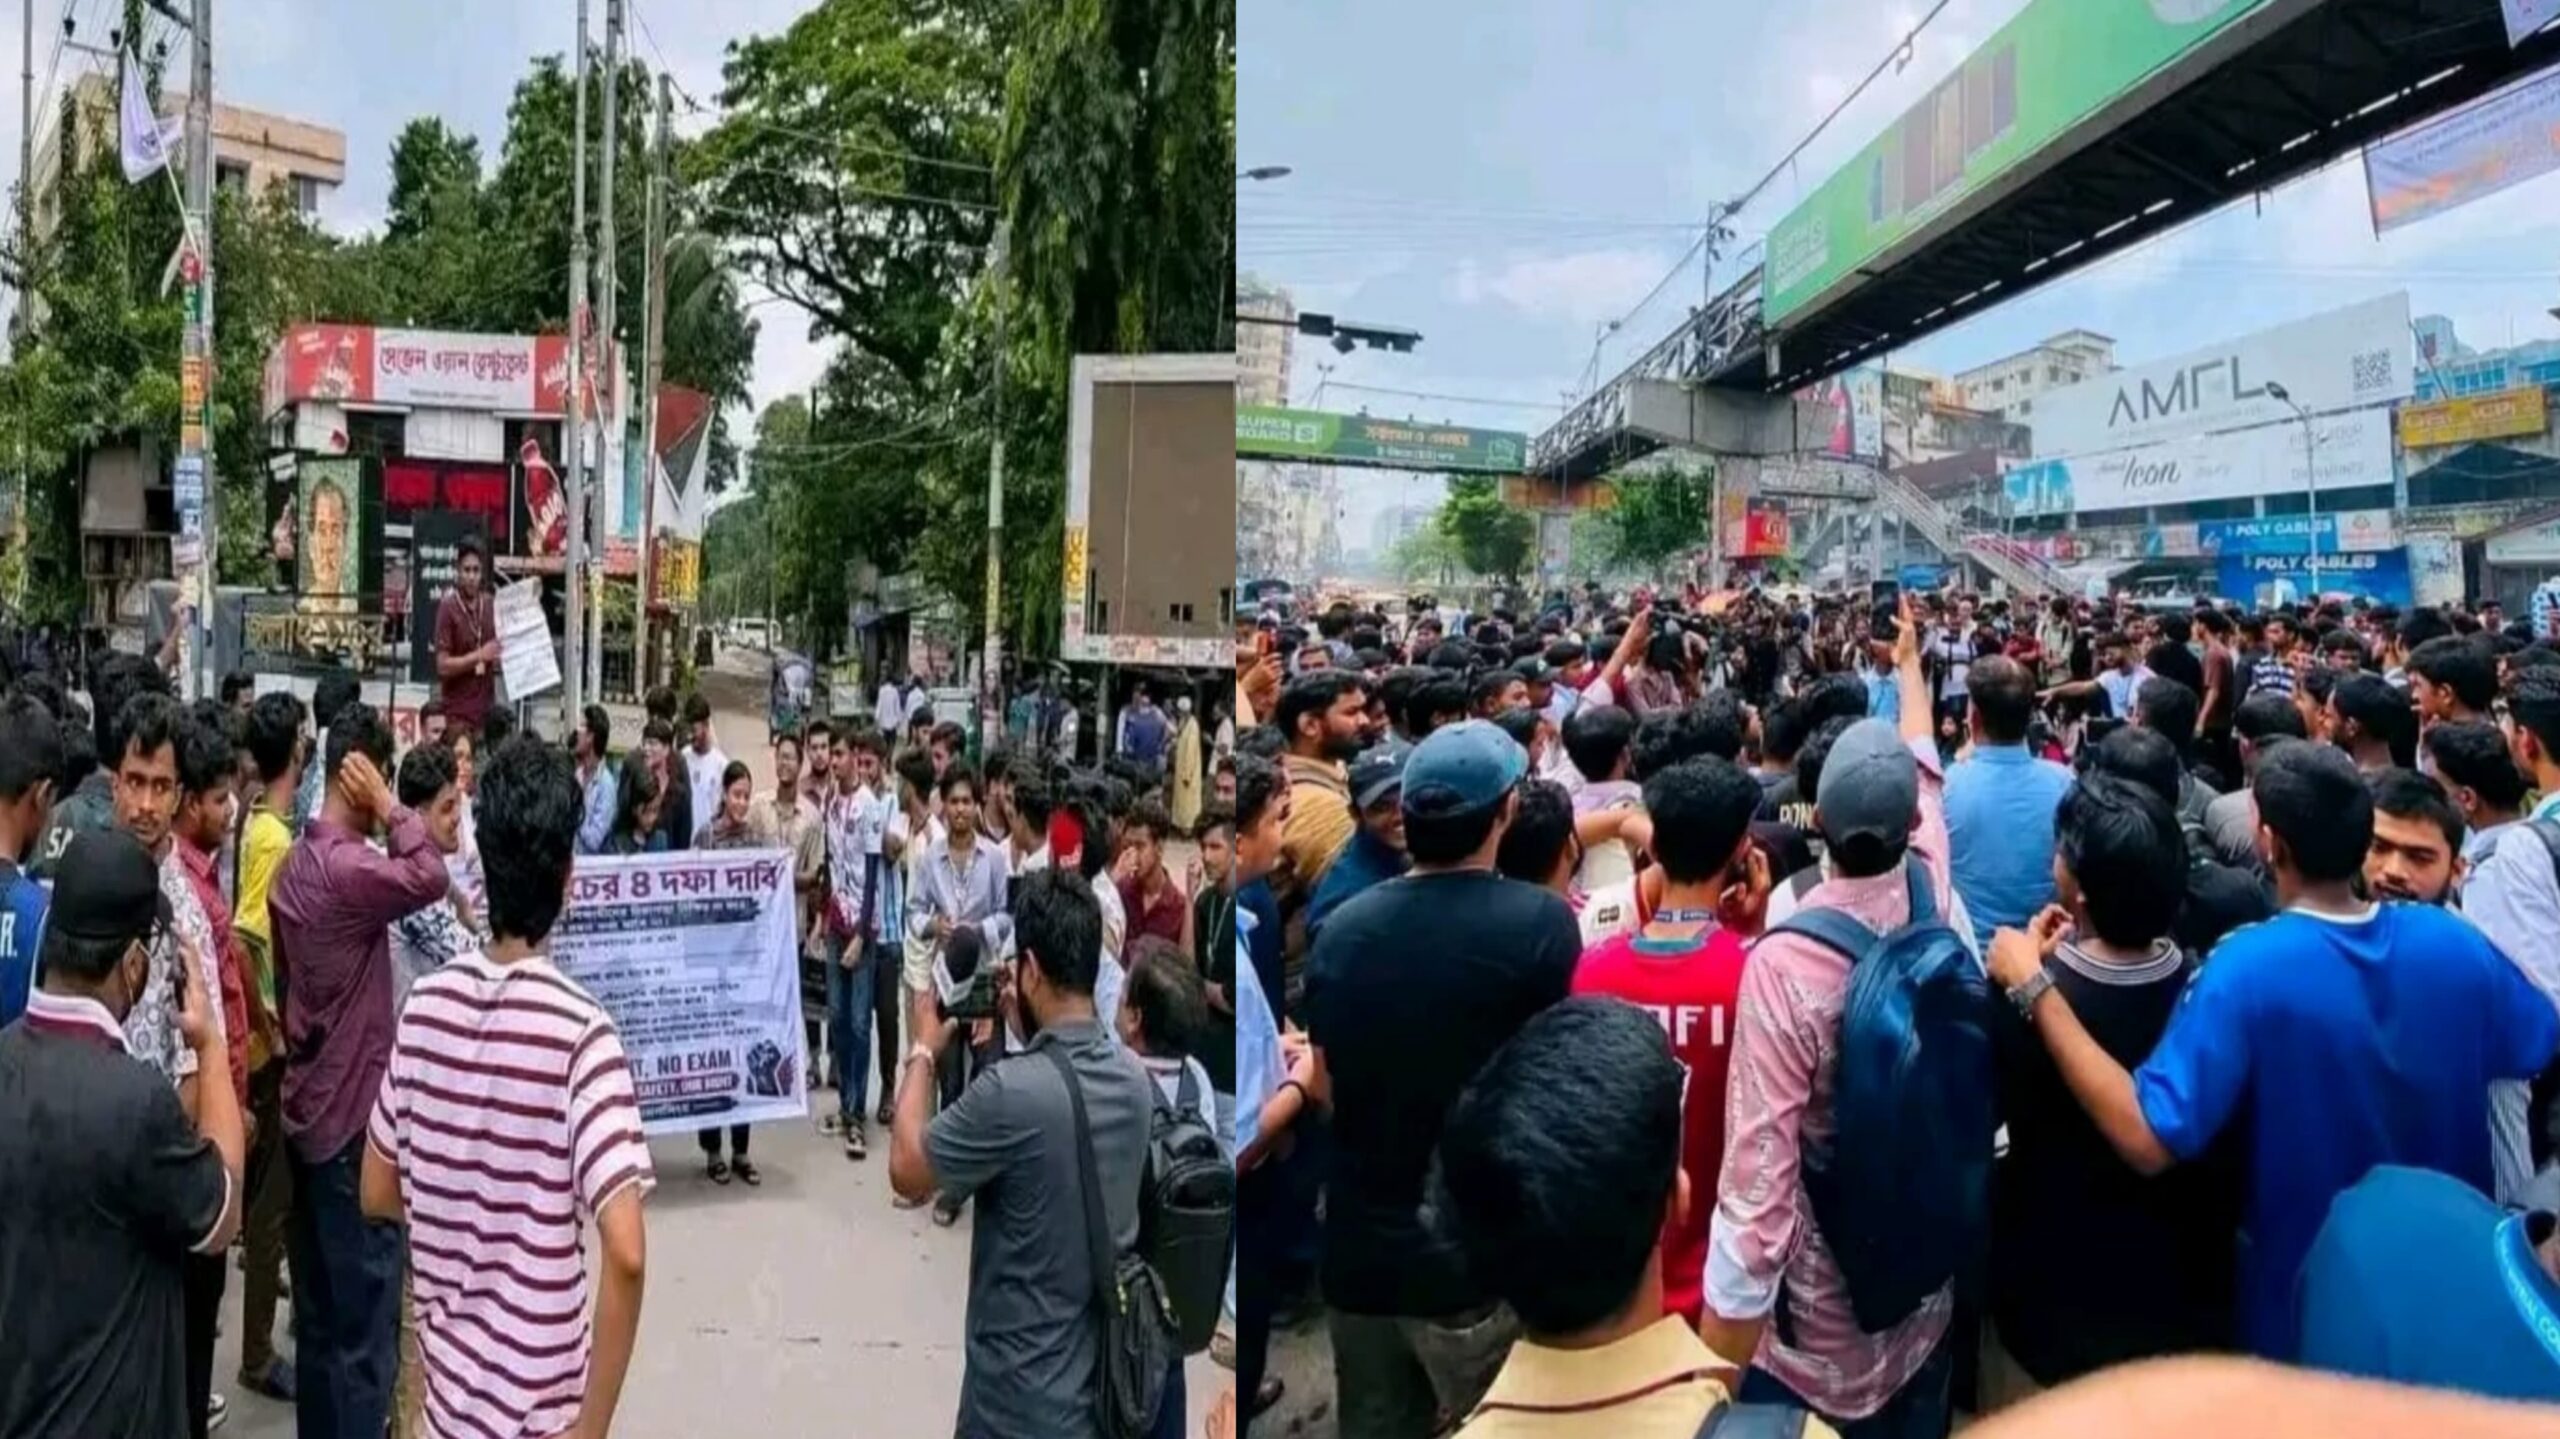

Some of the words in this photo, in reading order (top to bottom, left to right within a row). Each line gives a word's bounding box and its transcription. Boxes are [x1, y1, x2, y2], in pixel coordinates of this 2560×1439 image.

[2122, 455, 2181, 488] Icon
[2236, 521, 2269, 537] POLY
[2275, 518, 2332, 536] CABLES
[2254, 555, 2299, 571] POLY
[2303, 553, 2377, 570] CABLES
[631, 871, 652, 899] ৪
[659, 867, 717, 896] দফা
[725, 860, 779, 892] দাবি
[657, 1055, 682, 1076] NO
[687, 1049, 732, 1072] EXAM
